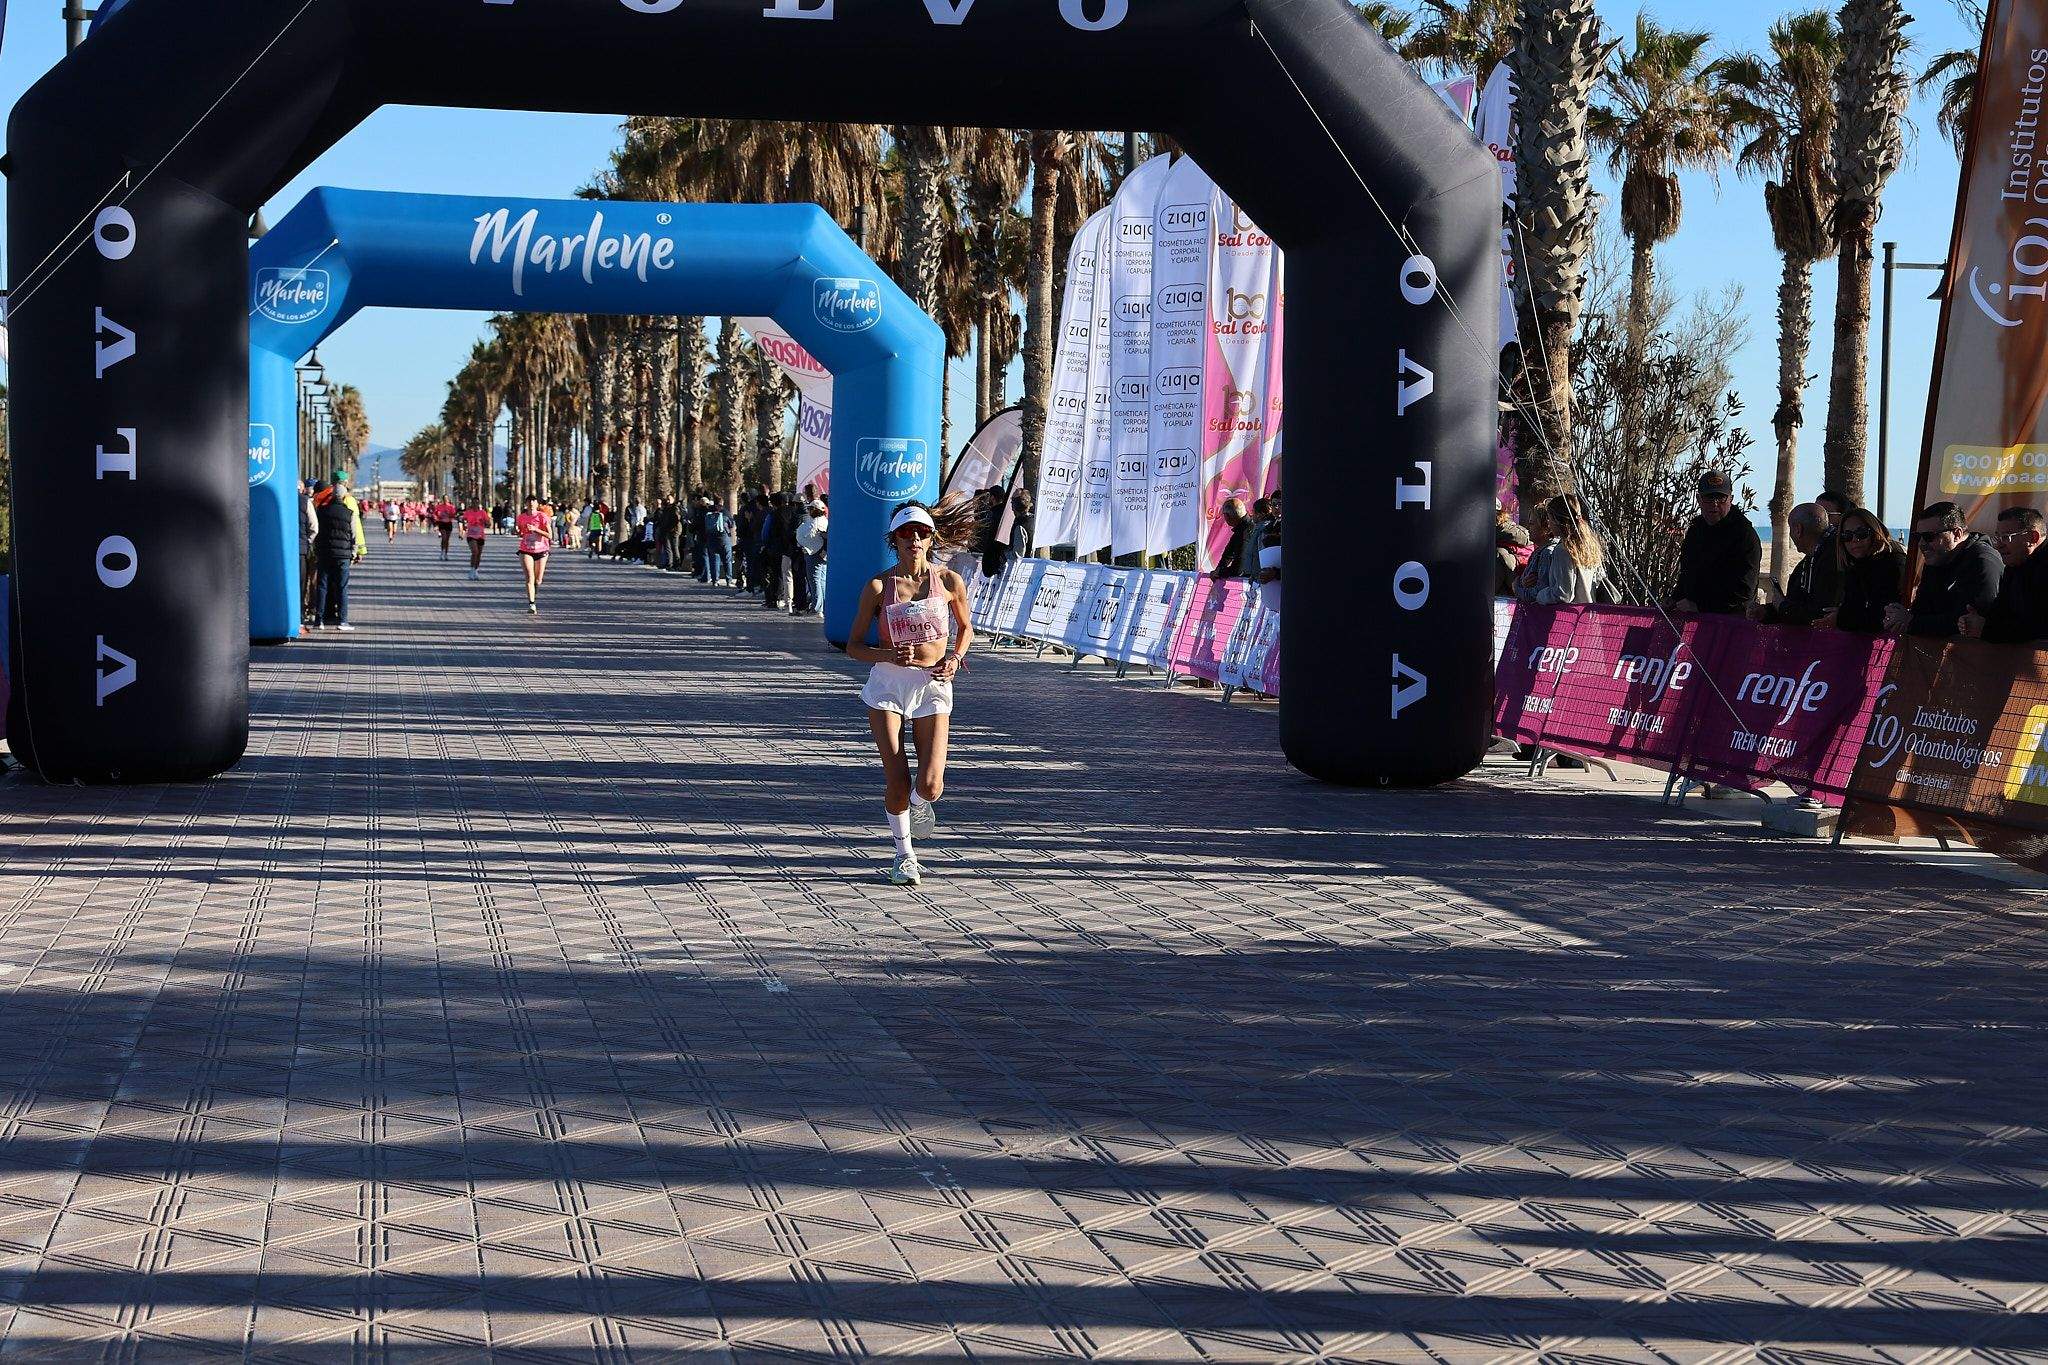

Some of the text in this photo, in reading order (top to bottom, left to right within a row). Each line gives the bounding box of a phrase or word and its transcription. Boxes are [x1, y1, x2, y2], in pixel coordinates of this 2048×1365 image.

[94, 205, 138, 706] VOLVO
[1391, 254, 1437, 719] VOLVO
[1612, 642, 1692, 703] renfe
[1736, 660, 1829, 726] renfe
[1607, 707, 1666, 734] TREN OFICIAL
[1730, 730, 1757, 752] TREN
[1912, 704, 1979, 735] Institutos
[1904, 732, 2003, 769] Odontológicos
